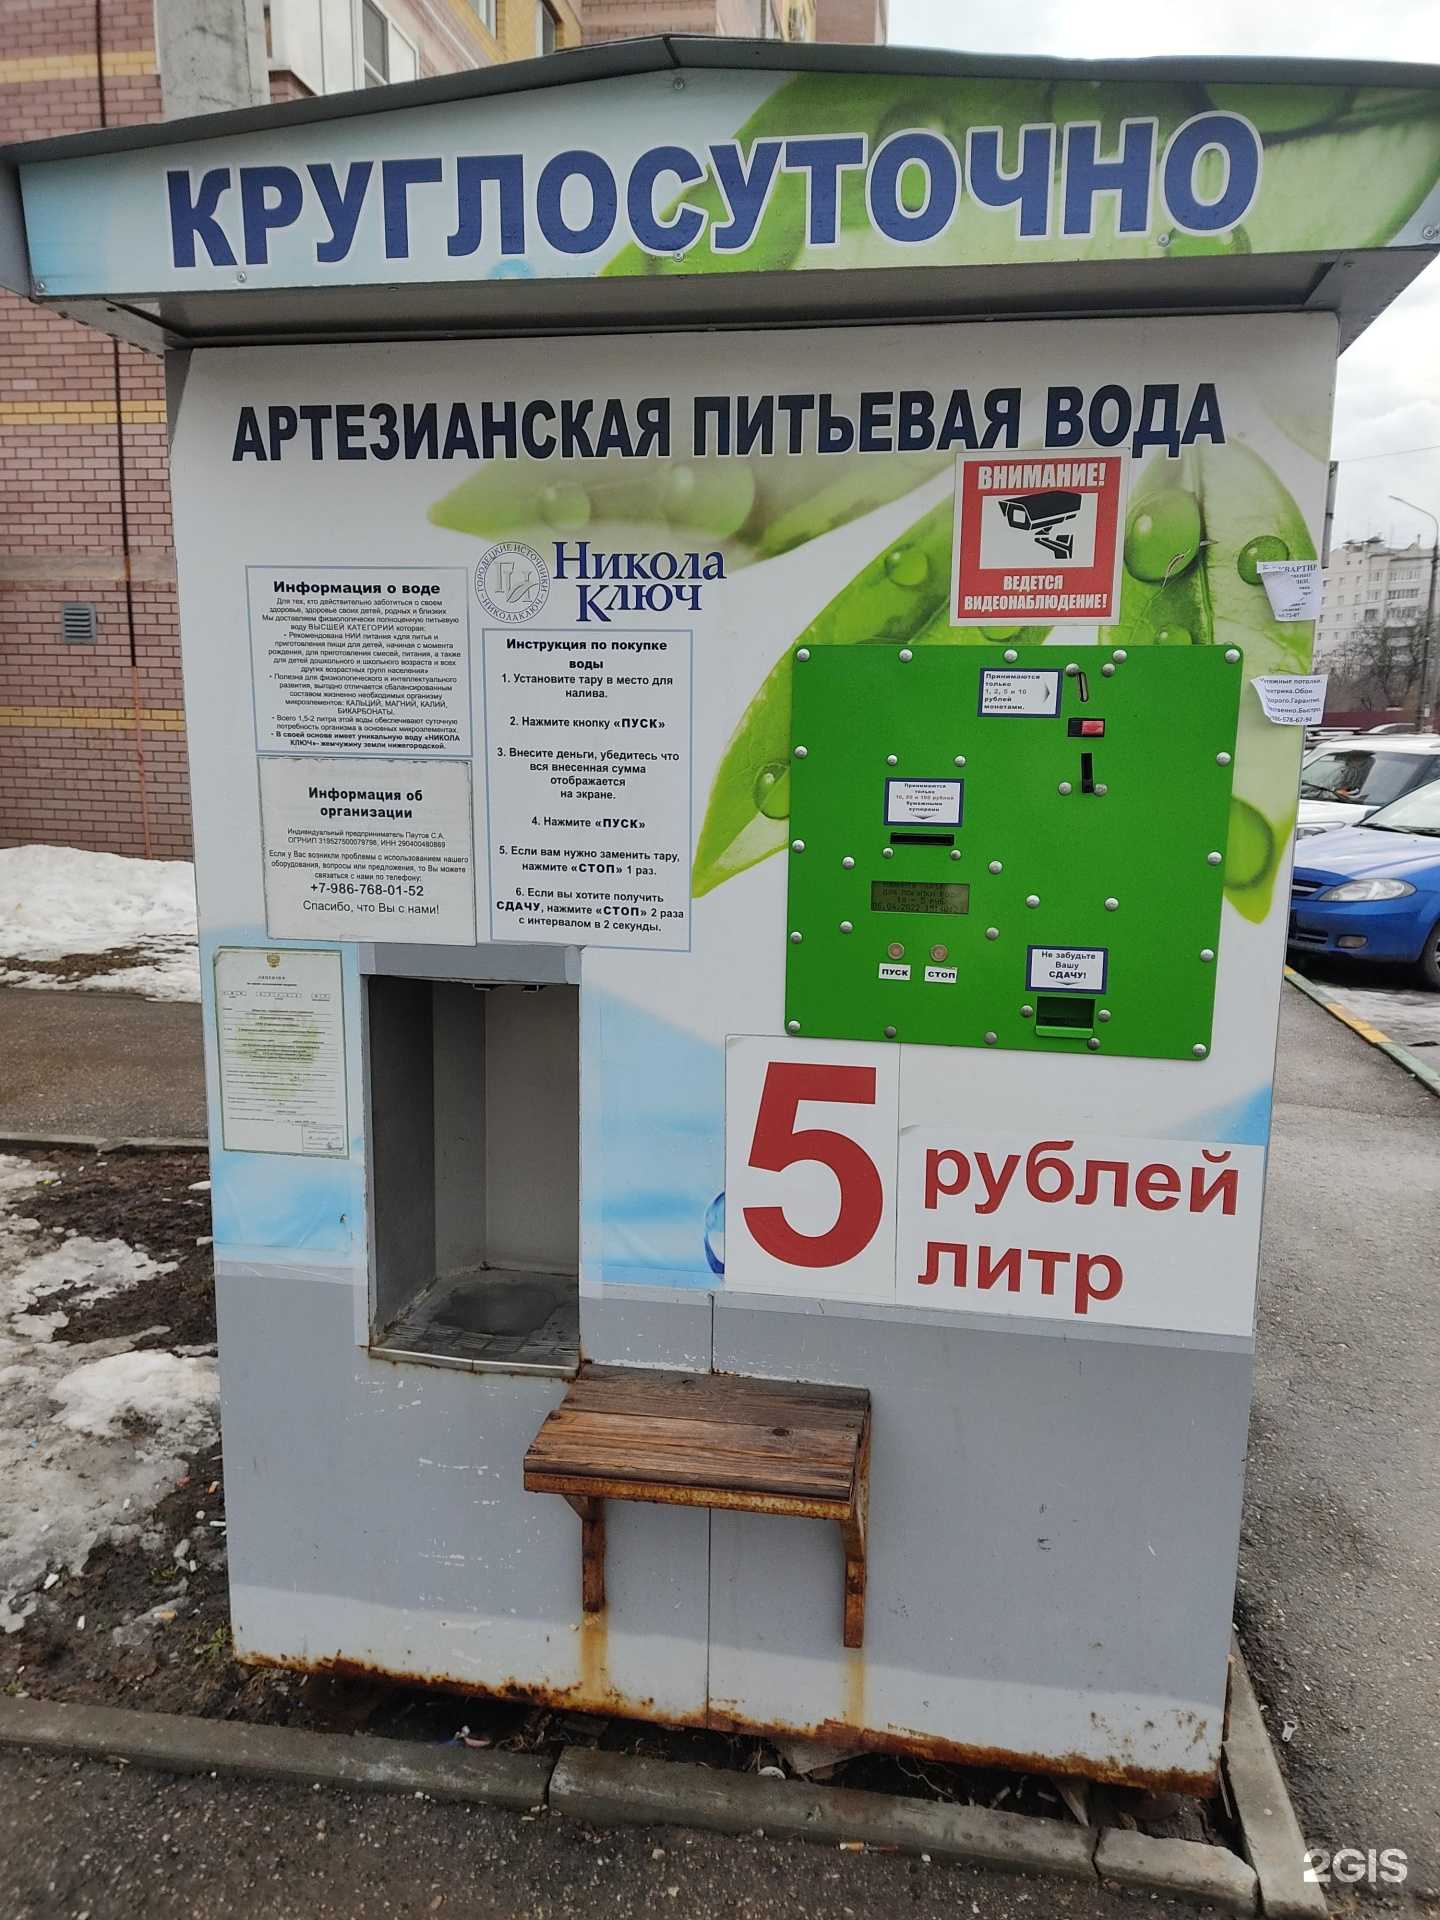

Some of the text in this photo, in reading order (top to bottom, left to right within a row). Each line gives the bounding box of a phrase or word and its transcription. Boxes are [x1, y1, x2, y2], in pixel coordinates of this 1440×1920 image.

[167, 112, 1260, 268] КРУГЛОСУТОЧНО
[232, 383, 1225, 461] АРТЕЗИАНСКАЯ ПИТЬЕВАЯ ВОДА
[978, 463, 1106, 490] ВНИМАНИЕ!
[552, 542, 727, 580] Никола
[274, 581, 440, 595] Информация о воде
[1004, 575, 1063, 592] ВЕДЕТСЯ
[576, 584, 702, 622] Ключ
[965, 594, 1108, 612] ВИДЕОНАБЛЮДЕНИЕ!
[507, 639, 667, 652] Инструкция по покупке
[569, 660, 603, 670] воды
[502, 674, 510, 683] 1.
[514, 674, 575, 684] Установите
[579, 676, 602, 686] тару
[617, 677, 648, 685] место
[652, 677, 673, 686] для
[566, 690, 608, 698] налива.
[510, 716, 665, 729] 2. Нажмите кнопку «ПУСК»
[497, 748, 679, 761] 3. Внесите деньги, убедитесь что
[530, 763, 646, 774] вся внесенная сумма
[551, 776, 625, 787] отображается
[309, 787, 422, 801] Информация об
[561, 790, 616, 800] на экране.
[320, 807, 412, 820] организации
[532, 817, 645, 829] 4. Нажмите «ПУСК»
[341, 853, 376, 862] проблемы
[384, 855, 441, 863] использованием
[499, 846, 679, 863] 5. Если вам нужно заменить тару,
[272, 860, 321, 870] оборудования,
[368, 864, 416, 873] предложения,
[522, 863, 657, 876] нажмите «СТОП» 1 раз.
[315, 872, 348, 880] связаться
[310, 883, 424, 897] +7-986-768-01-52
[516, 888, 664, 903] 6. Если вы хотите получить
[303, 901, 439, 914] Спасибо, что Вы с нами!
[497, 901, 683, 919] СДАЧУ, нажмите «СТОП» 2 раза
[528, 918, 591, 929] интервалом
[595, 920, 600, 928] в
[604, 920, 609, 929] 2
[613, 921, 661, 932] секунды.
[1056, 952, 1095, 960] забудьте
[1056, 962, 1079, 970] Вашу
[1049, 971, 1086, 979] СДАЧУ!
[743, 1061, 883, 1268] 5
[925, 1140, 1239, 1215] рублей
[918, 1241, 1123, 1315] литр
